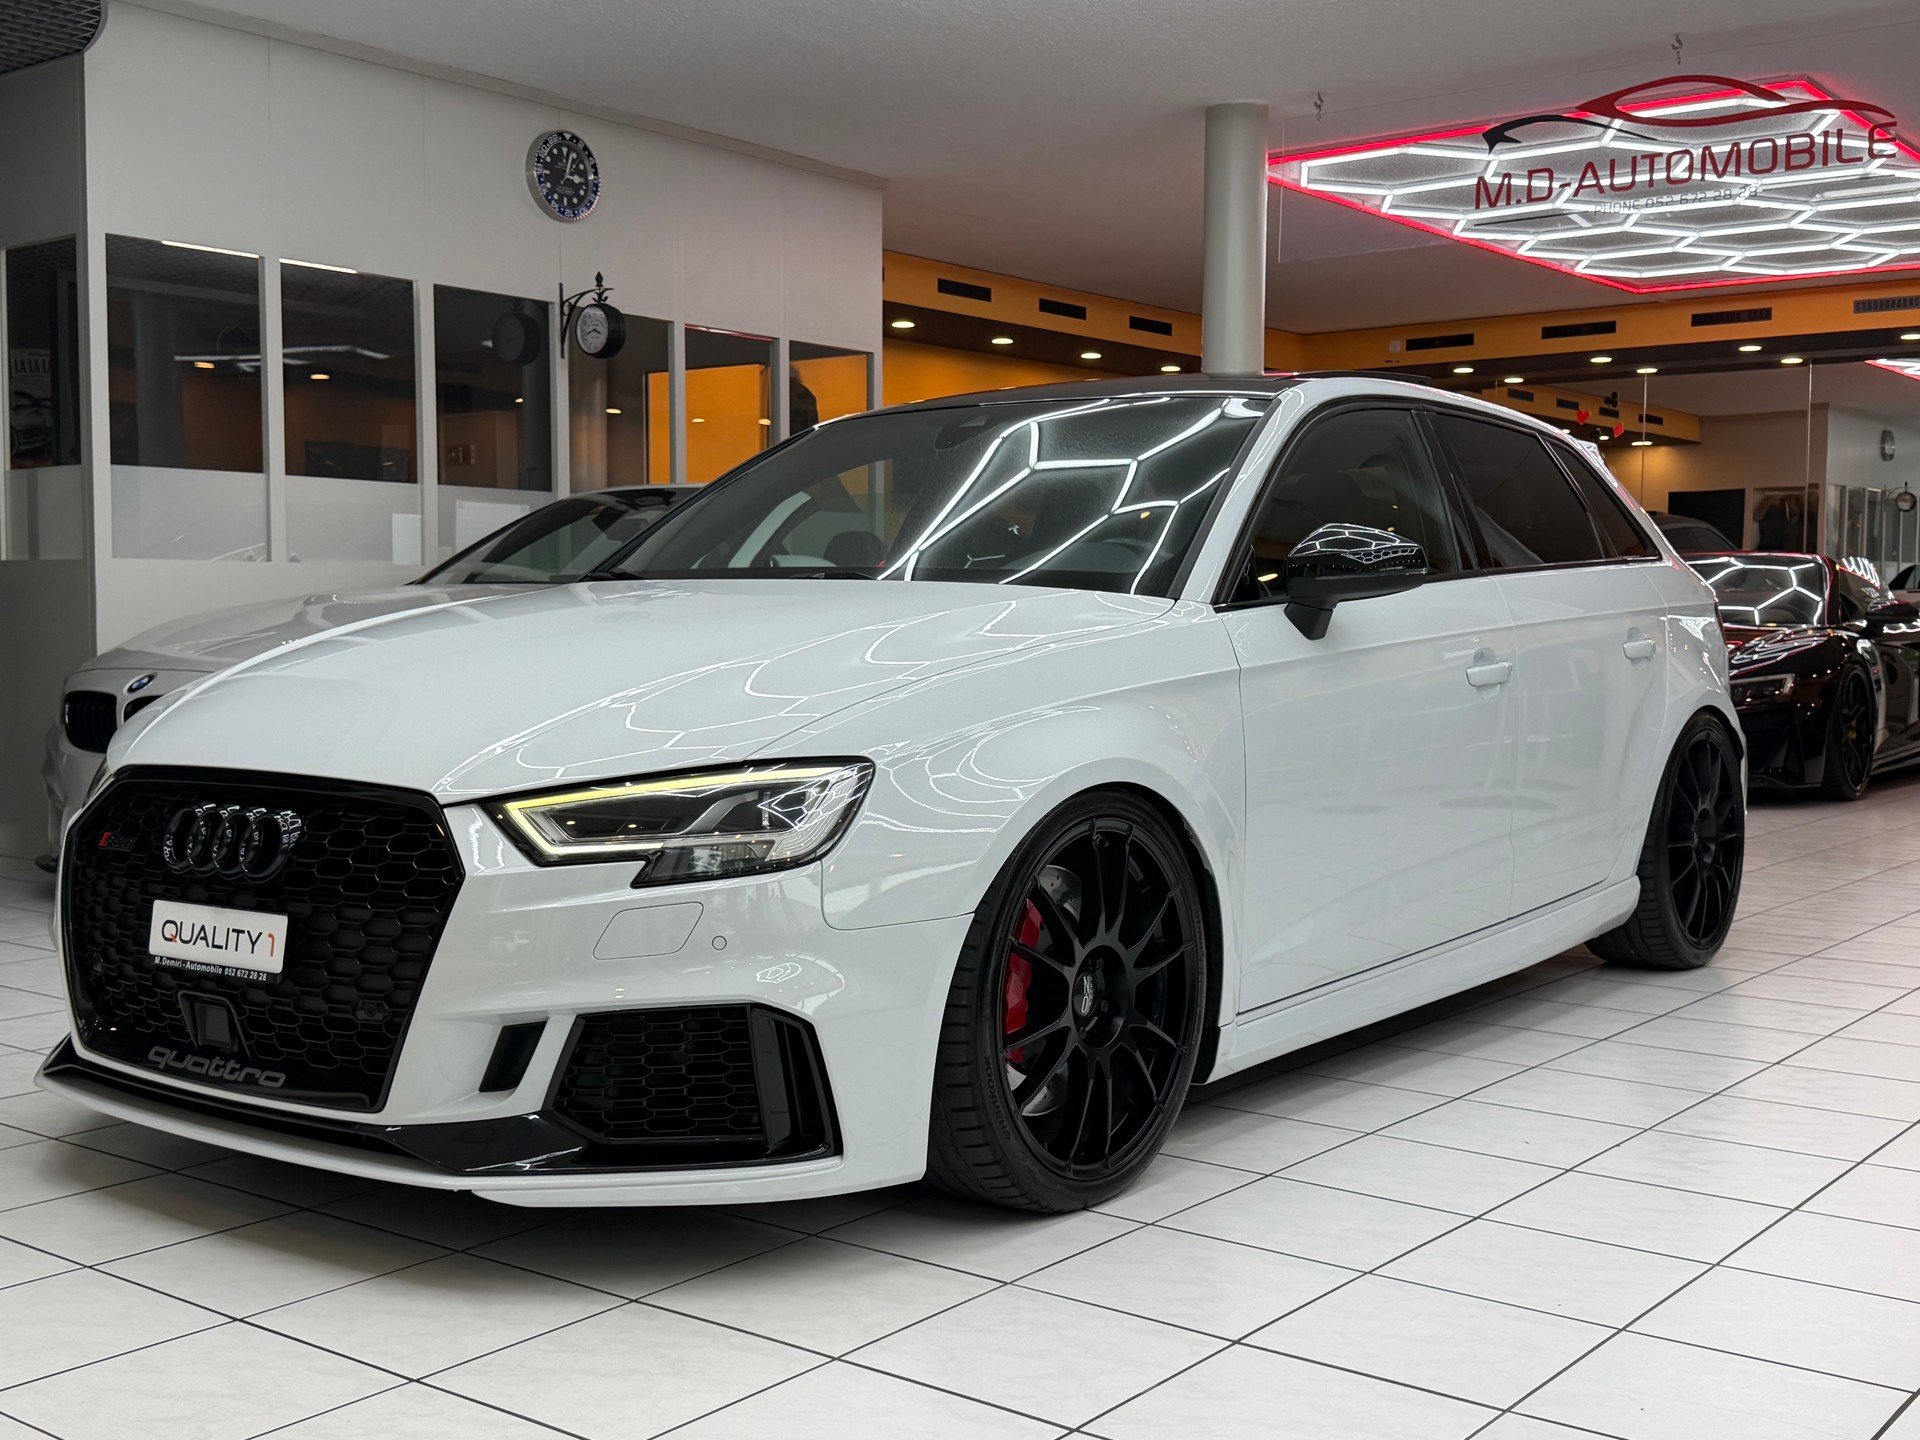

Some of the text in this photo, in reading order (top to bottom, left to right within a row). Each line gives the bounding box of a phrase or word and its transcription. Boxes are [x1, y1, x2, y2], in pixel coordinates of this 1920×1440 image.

[1474, 121, 1899, 210] M.D-AUTOMOBILE
[1594, 200, 1640, 215] PHONE
[1645, 195, 1673, 208] 052
[1679, 192, 1707, 205] 672
[1713, 188, 1732, 201] 28
[161, 919, 263, 955] QUALITY
[186, 961, 222, 974] Automobile
[224, 969, 236, 977] 052
[249, 972, 257, 980] 28
[258, 973, 267, 981] 28
[147, 1045, 286, 1088] quattro
